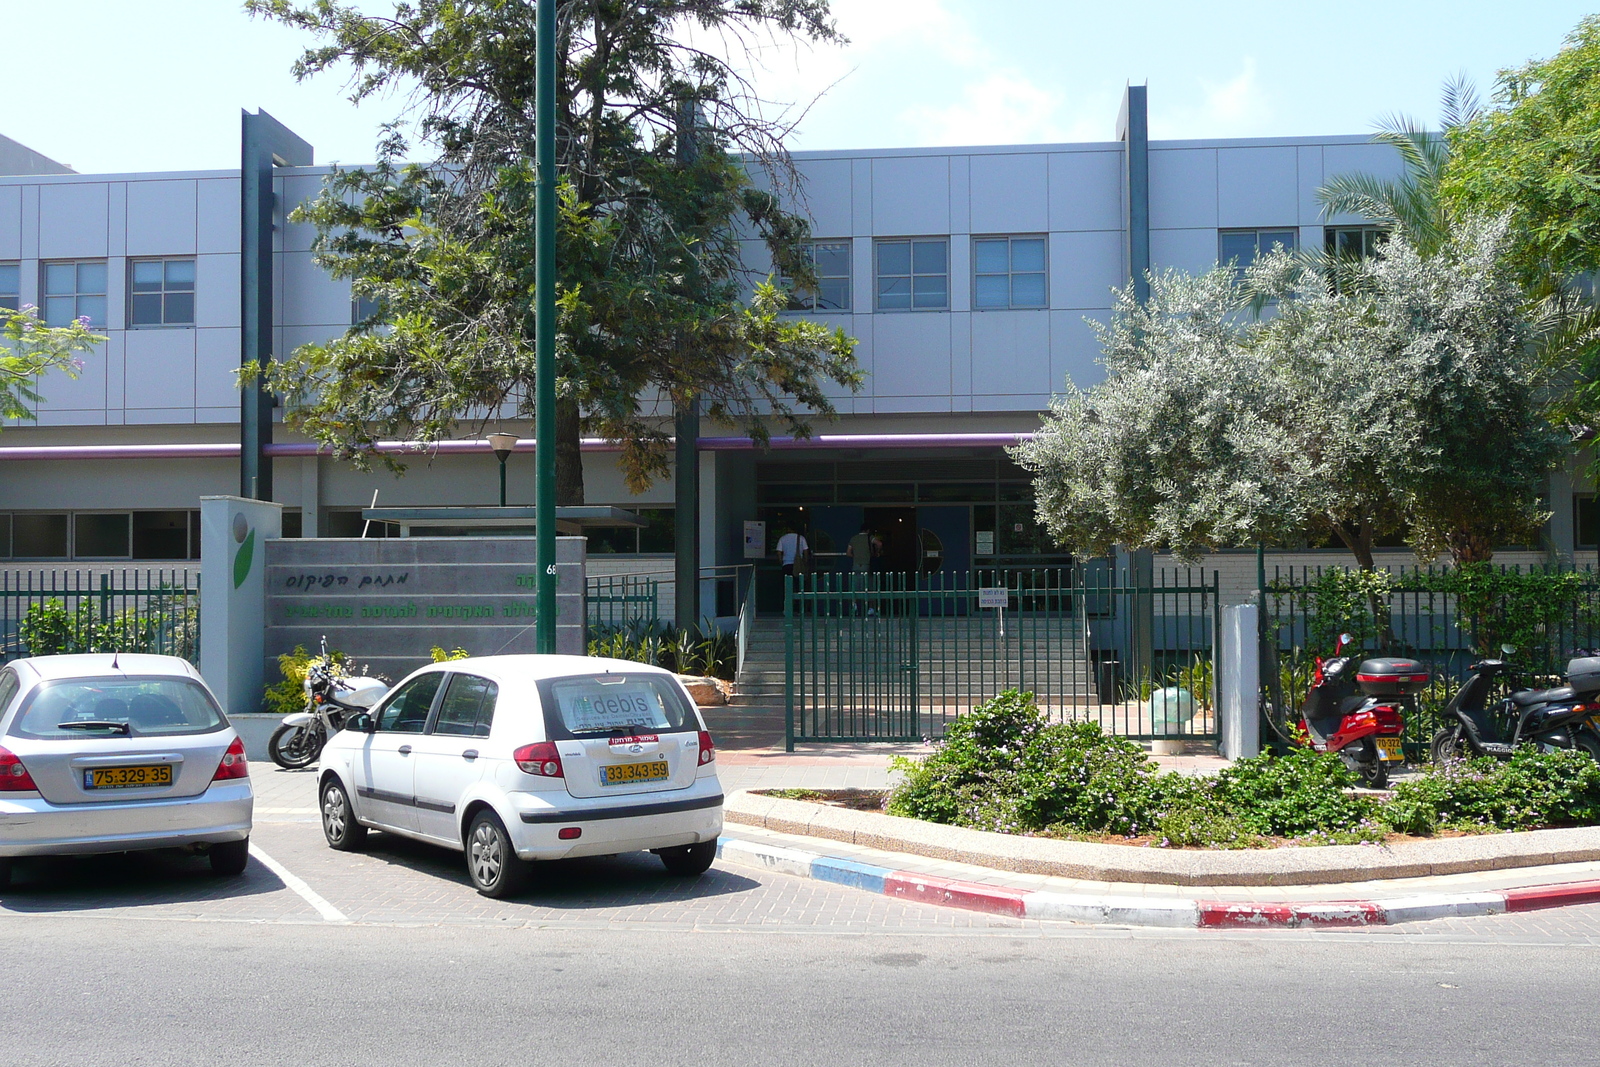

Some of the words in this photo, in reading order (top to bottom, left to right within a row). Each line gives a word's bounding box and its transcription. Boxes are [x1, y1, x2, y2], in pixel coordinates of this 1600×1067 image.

[546, 564, 557, 575] 68
[286, 574, 349, 592] הפיקוס
[358, 572, 408, 588] מתחם
[285, 601, 353, 618] בתל-אביב
[361, 600, 417, 618] להנדסה
[427, 605, 494, 620] האקדמית
[593, 694, 648, 715] debis
[1376, 738, 1400, 748] 70-322
[1486, 746, 1512, 754] PIAGGIO
[1387, 747, 1396, 757] 14
